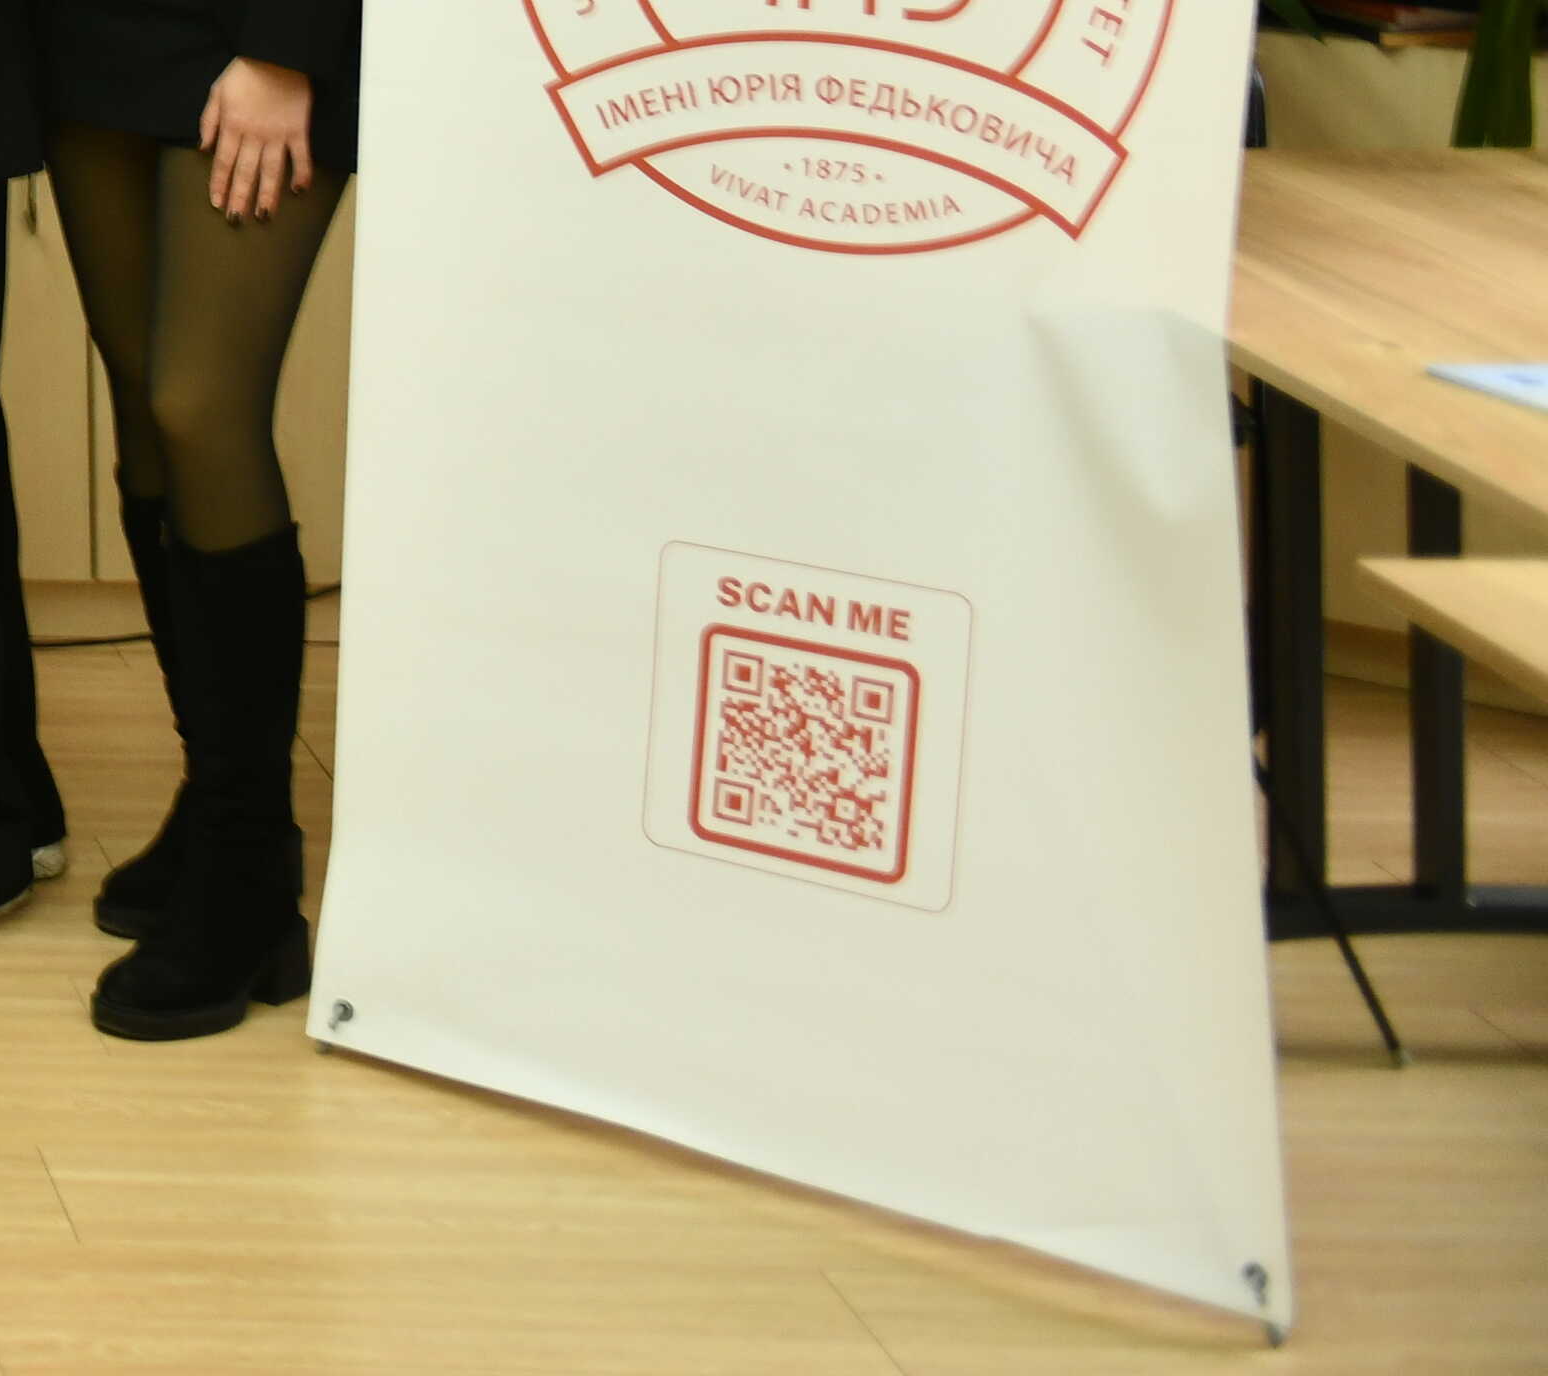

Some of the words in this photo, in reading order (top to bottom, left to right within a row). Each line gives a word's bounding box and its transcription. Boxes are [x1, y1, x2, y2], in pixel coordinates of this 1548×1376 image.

[594, 79, 699, 131] ІМЕНІ
[708, 72, 804, 107] ЮРІЯ
[814, 75, 1079, 188] ФЕДЬКОВИЧА
[708, 163, 790, 215] VIVAT
[798, 192, 963, 227] ACADEMIA
[801, 156, 866, 185] 1875
[716, 575, 836, 627] SCAN
[847, 599, 912, 642] ME
